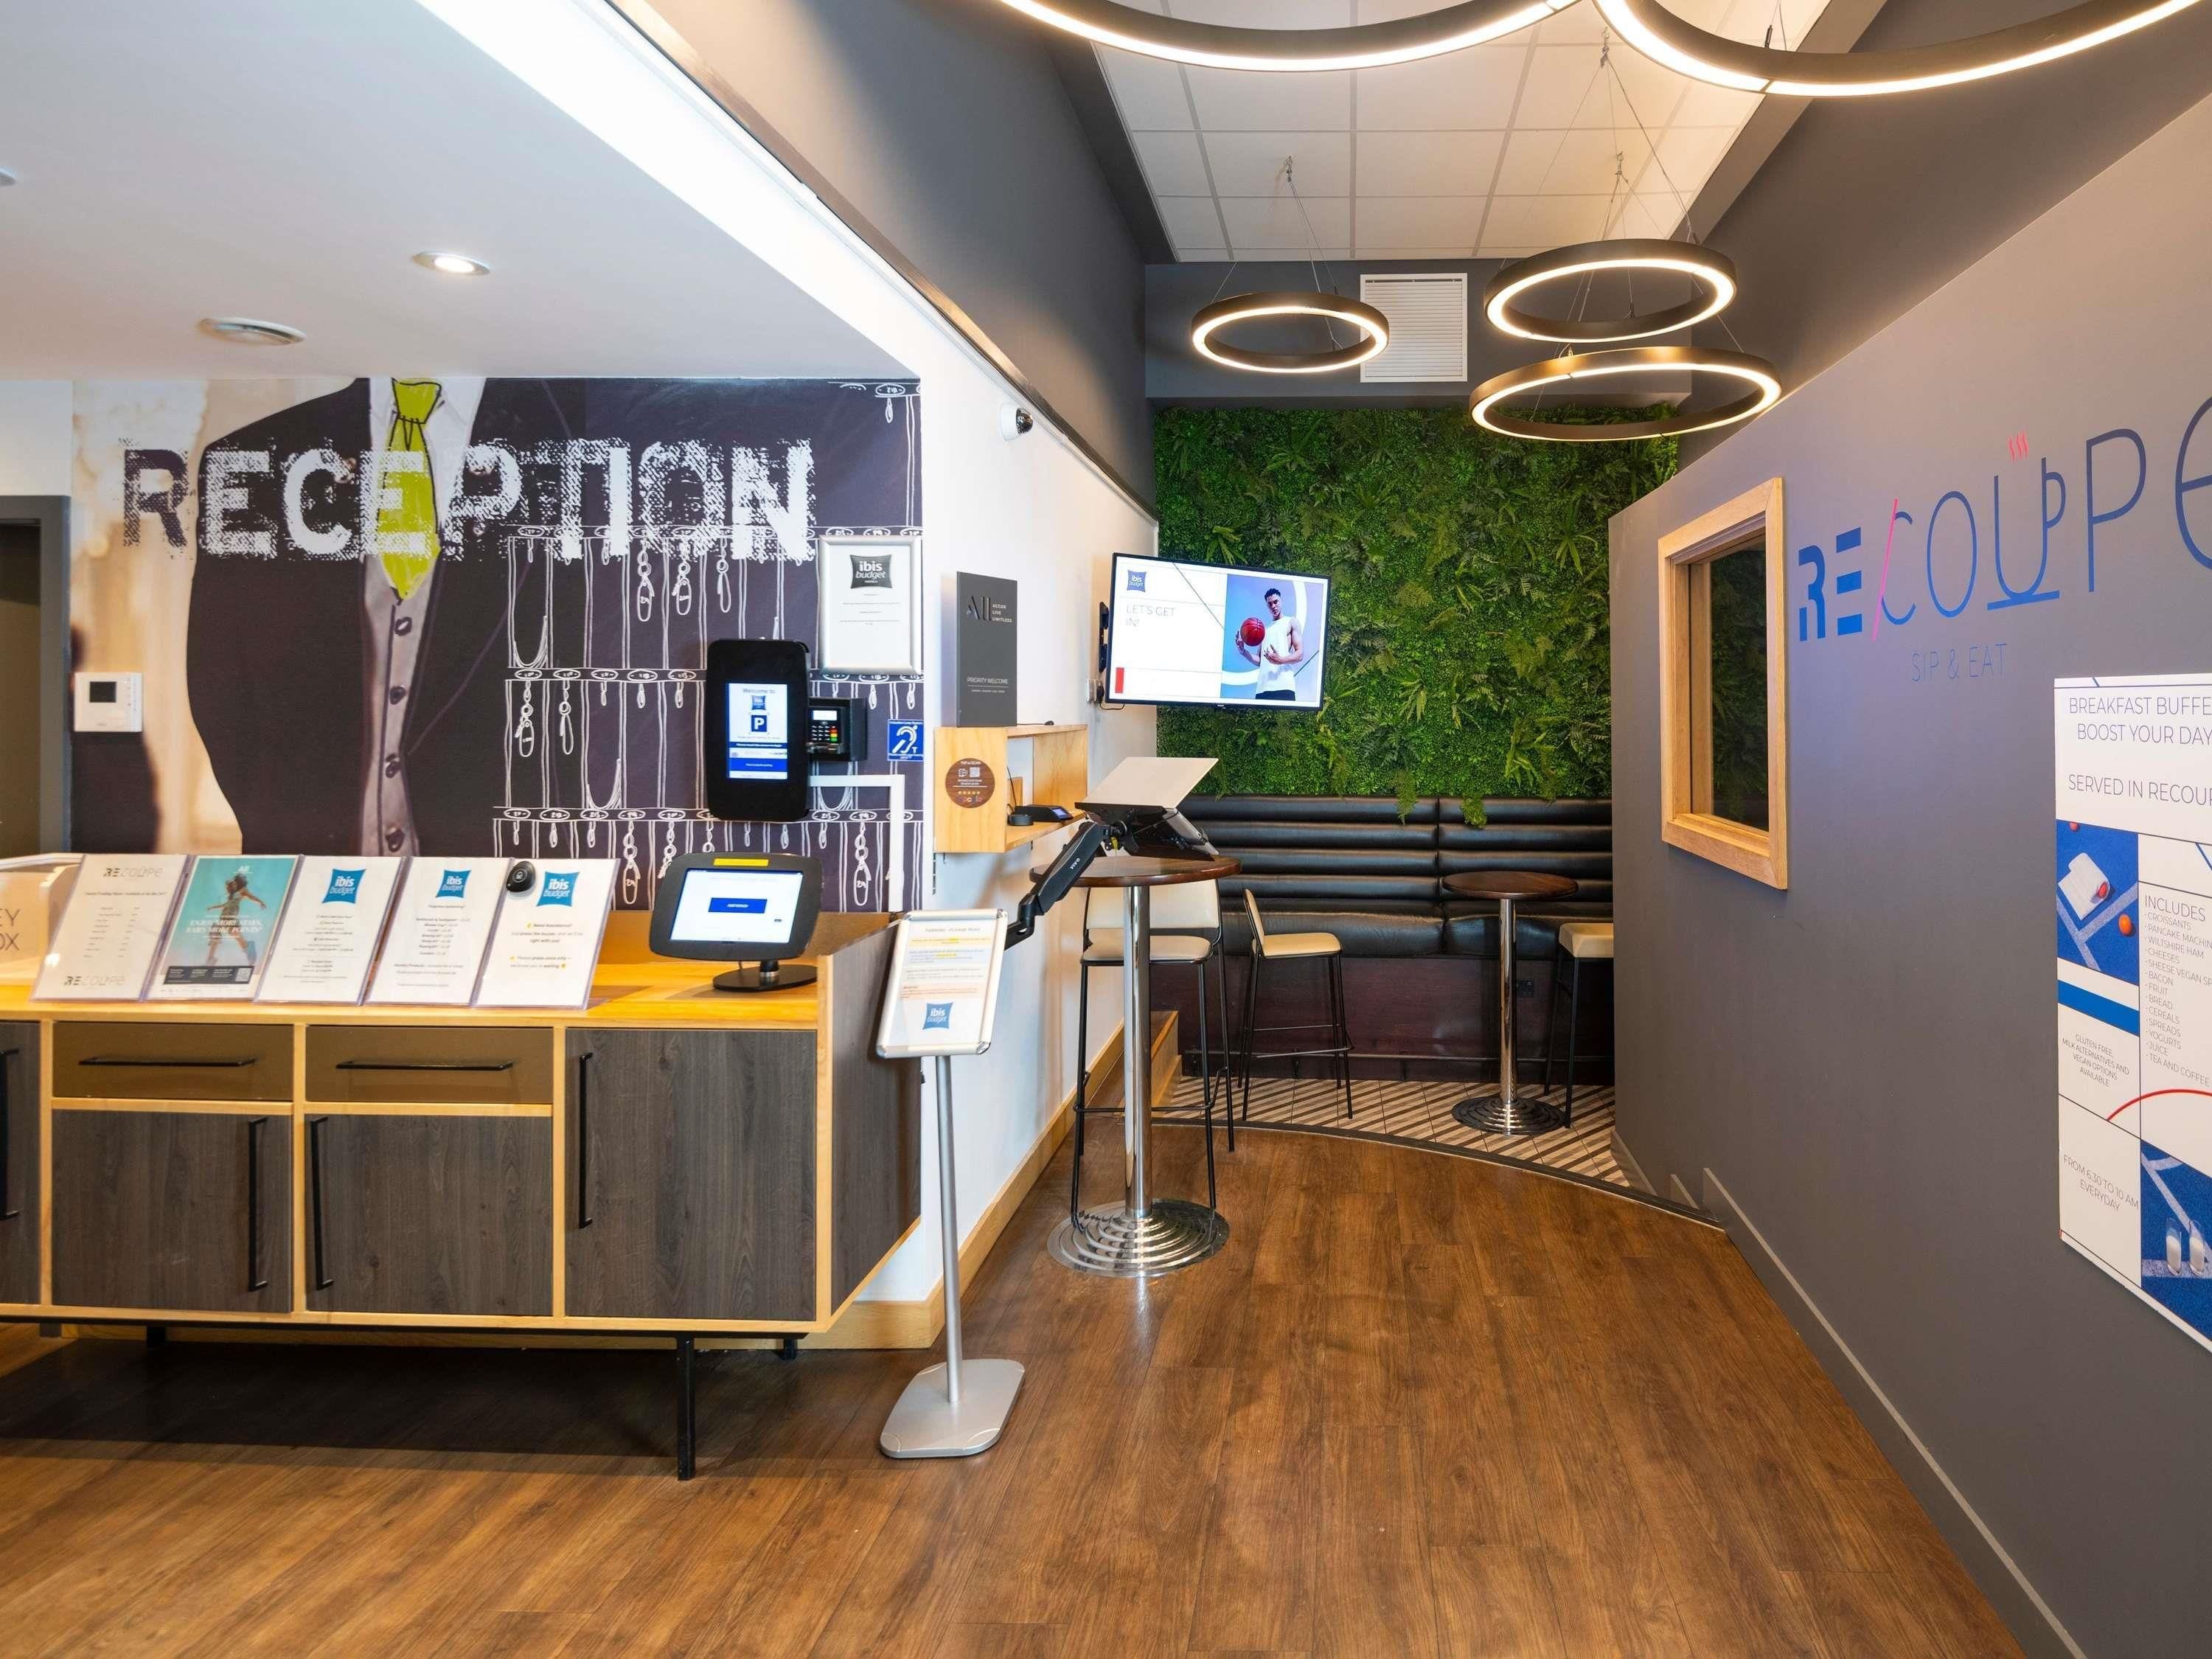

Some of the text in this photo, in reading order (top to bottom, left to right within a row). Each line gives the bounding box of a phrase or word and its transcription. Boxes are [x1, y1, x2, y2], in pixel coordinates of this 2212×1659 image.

[118, 438, 815, 562] RECEPTION
[859, 560, 883, 572] ibis
[855, 571, 886, 580] budget
[1130, 574, 1143, 582] ibis
[1156, 607, 1174, 617] GET
[1912, 643, 2008, 682] SIP & EAT
[2070, 697, 2152, 714] BREAKFAST
[2078, 723, 2126, 741] BOOST
[2129, 726, 2174, 743] YOUR
[2068, 774, 2124, 796] SERVED
[2129, 780, 2143, 798] IN
[335, 876, 354, 887] ibis
[446, 876, 462, 886] ibis
[548, 879, 569, 890] ibis
[330, 886, 355, 896] budget
[543, 889, 571, 899] budget
[2145, 894, 2206, 922] INCLUDES
[2148, 912, 2191, 931] CROISSANTS
[2148, 924, 2181, 941] PANCAKE
[2148, 936, 2204, 959] WILTSHIRE HAM
[2148, 947, 2180, 964] CHEESES
[2148, 959, 2175, 974] SHEESE
[2176, 968, 2202, 984] VEGAN
[2148, 971, 2174, 986] BACON
[2148, 982, 2168, 995] FRUIT
[2149, 995, 2173, 1010] BREAD
[930, 1007, 946, 1017] ibis
[2149, 1006, 2180, 1025] CEREALS
[2149, 1018, 2181, 1037] SPREADS
[2076, 1034, 2097, 1050] GLUTEN
[2149, 1029, 2181, 1050] YOGURTS
[2062, 1037, 2129, 1075] MILK ALTERNATIVES AND
[2149, 1041, 2168, 1057] JUICE
[2073, 1053, 2118, 1079] VEGAN OPTIONS
[2149, 1053, 2210, 1086] TEA AND COFFEE
[2079, 1067, 2110, 1087] AVAILABLE
[2064, 1154, 2085, 1175] FROM
[2104, 1179, 2114, 1193] TO
[2115, 1186, 2124, 1200] 10
[2125, 1194, 2139, 1210] AM
[2080, 1179, 2121, 1212] EVERYDAY
